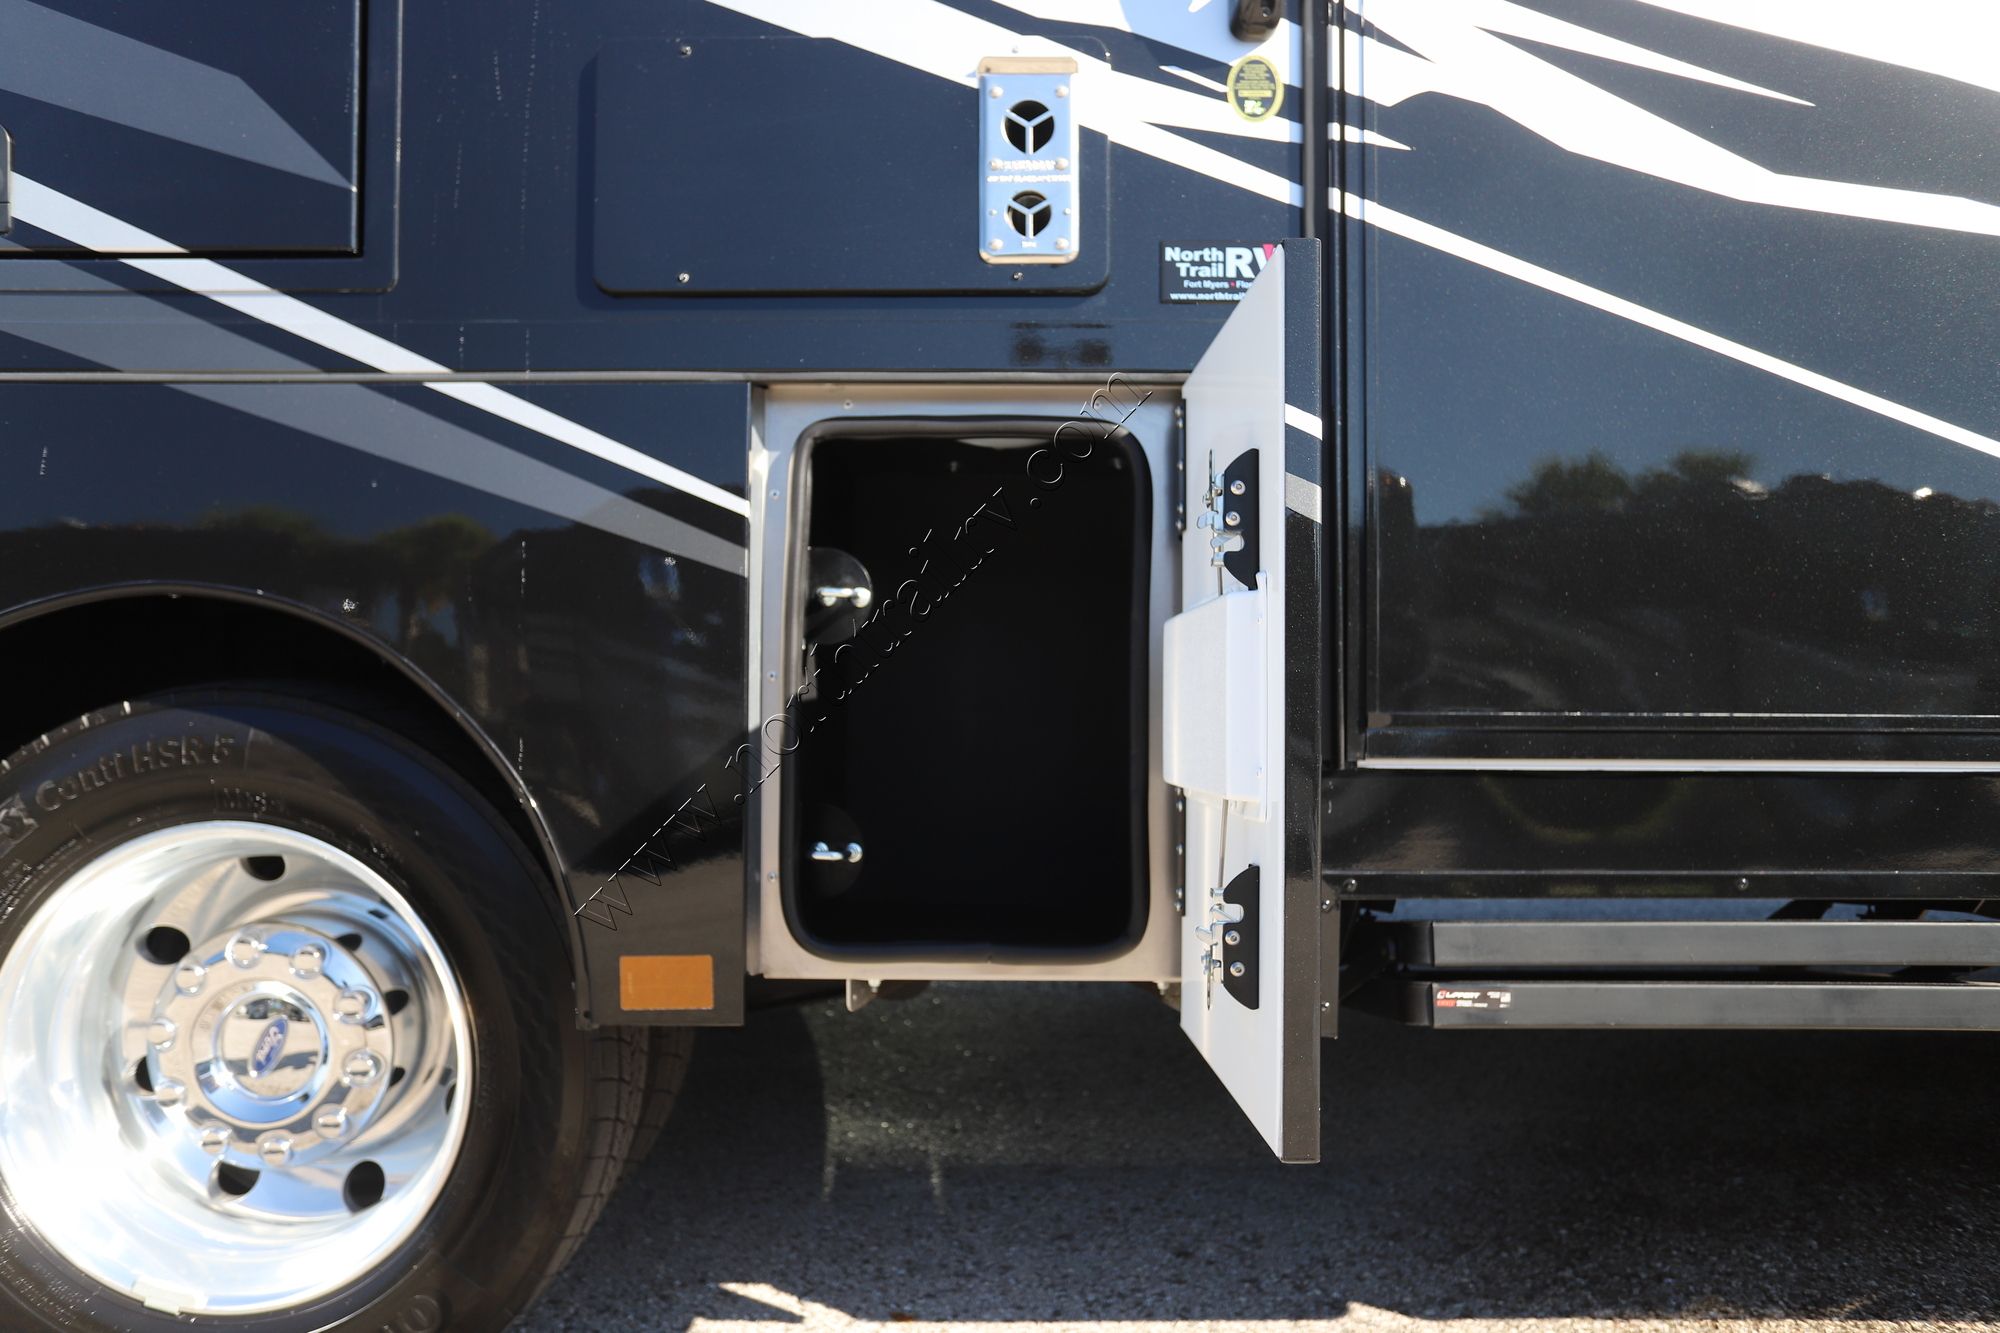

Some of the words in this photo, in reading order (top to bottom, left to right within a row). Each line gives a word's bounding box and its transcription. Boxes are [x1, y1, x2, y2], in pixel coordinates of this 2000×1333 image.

[1164, 246, 1225, 262] North
[1175, 262, 1224, 278] Trail
[1183, 280, 1202, 288] Fort
[1203, 280, 1229, 290] Myers
